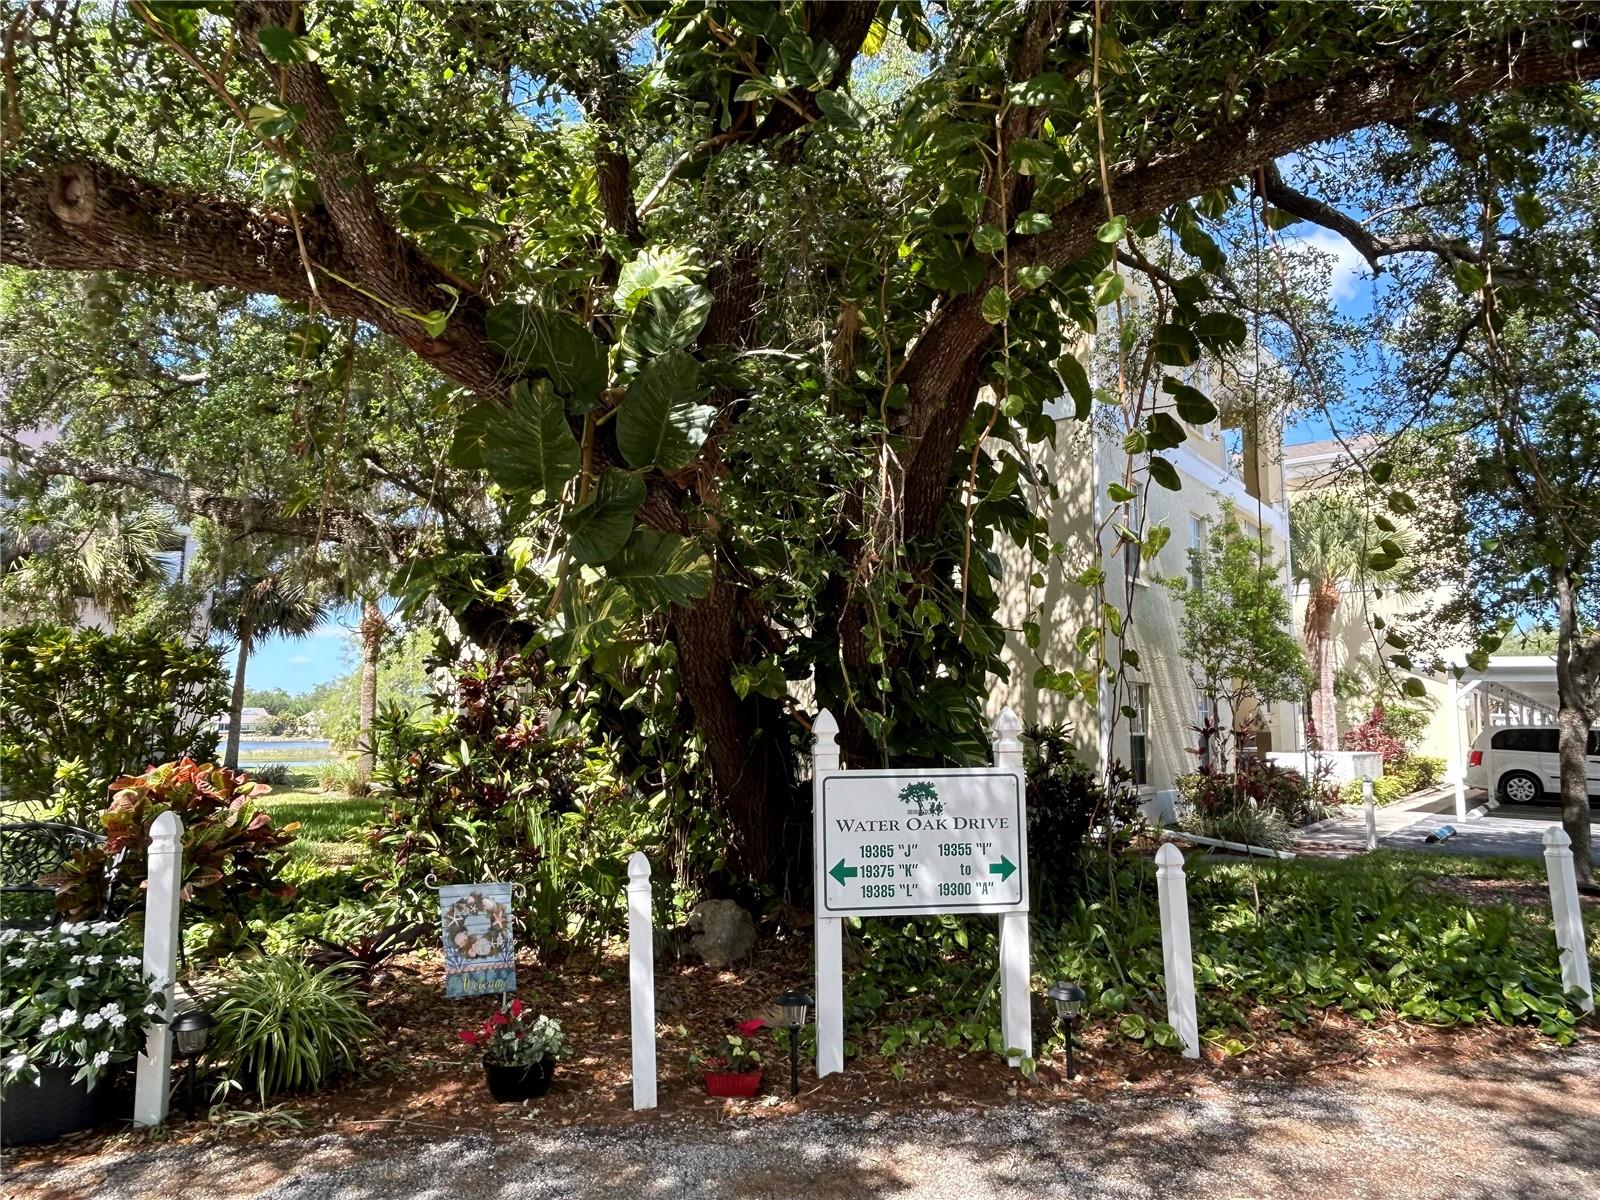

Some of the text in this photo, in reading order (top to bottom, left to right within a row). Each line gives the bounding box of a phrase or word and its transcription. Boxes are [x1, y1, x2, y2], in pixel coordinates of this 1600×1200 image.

[859, 844, 894, 858] 19365
[938, 843, 972, 856] 19355
[859, 864, 918, 878] 19375 "K"
[960, 863, 971, 876] to
[861, 884, 918, 898] 19385 "L"
[938, 882, 994, 896] 19300 "A"
